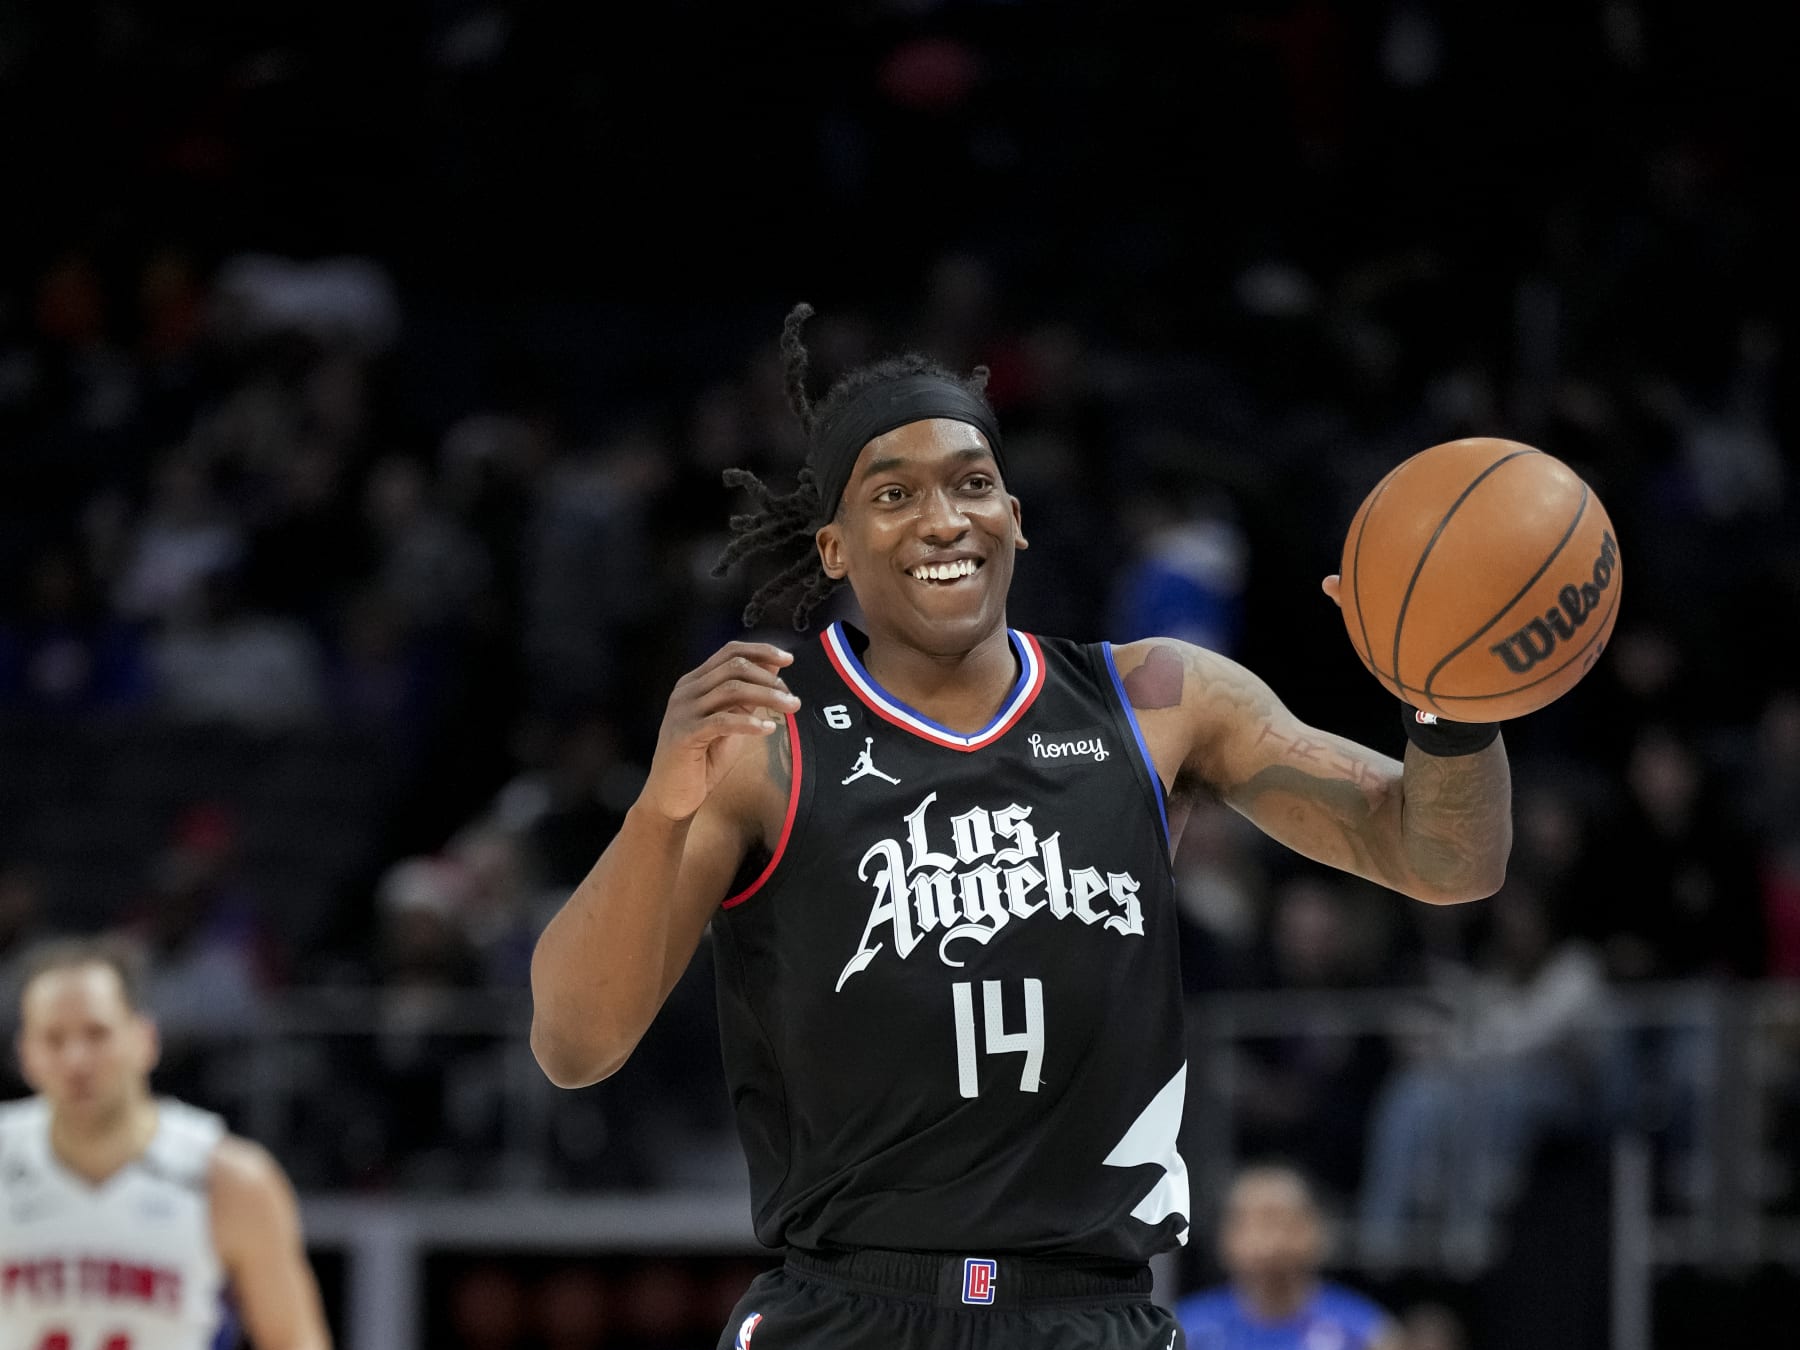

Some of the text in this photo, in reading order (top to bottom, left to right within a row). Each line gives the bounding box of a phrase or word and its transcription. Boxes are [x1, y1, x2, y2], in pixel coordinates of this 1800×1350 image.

[1489, 529, 1617, 674] Wilson
[823, 704, 852, 730] 6
[1028, 733, 1110, 762] honey
[903, 792, 1039, 875] Los
[835, 831, 1145, 993] Angeles
[952, 977, 1046, 1099] 14
